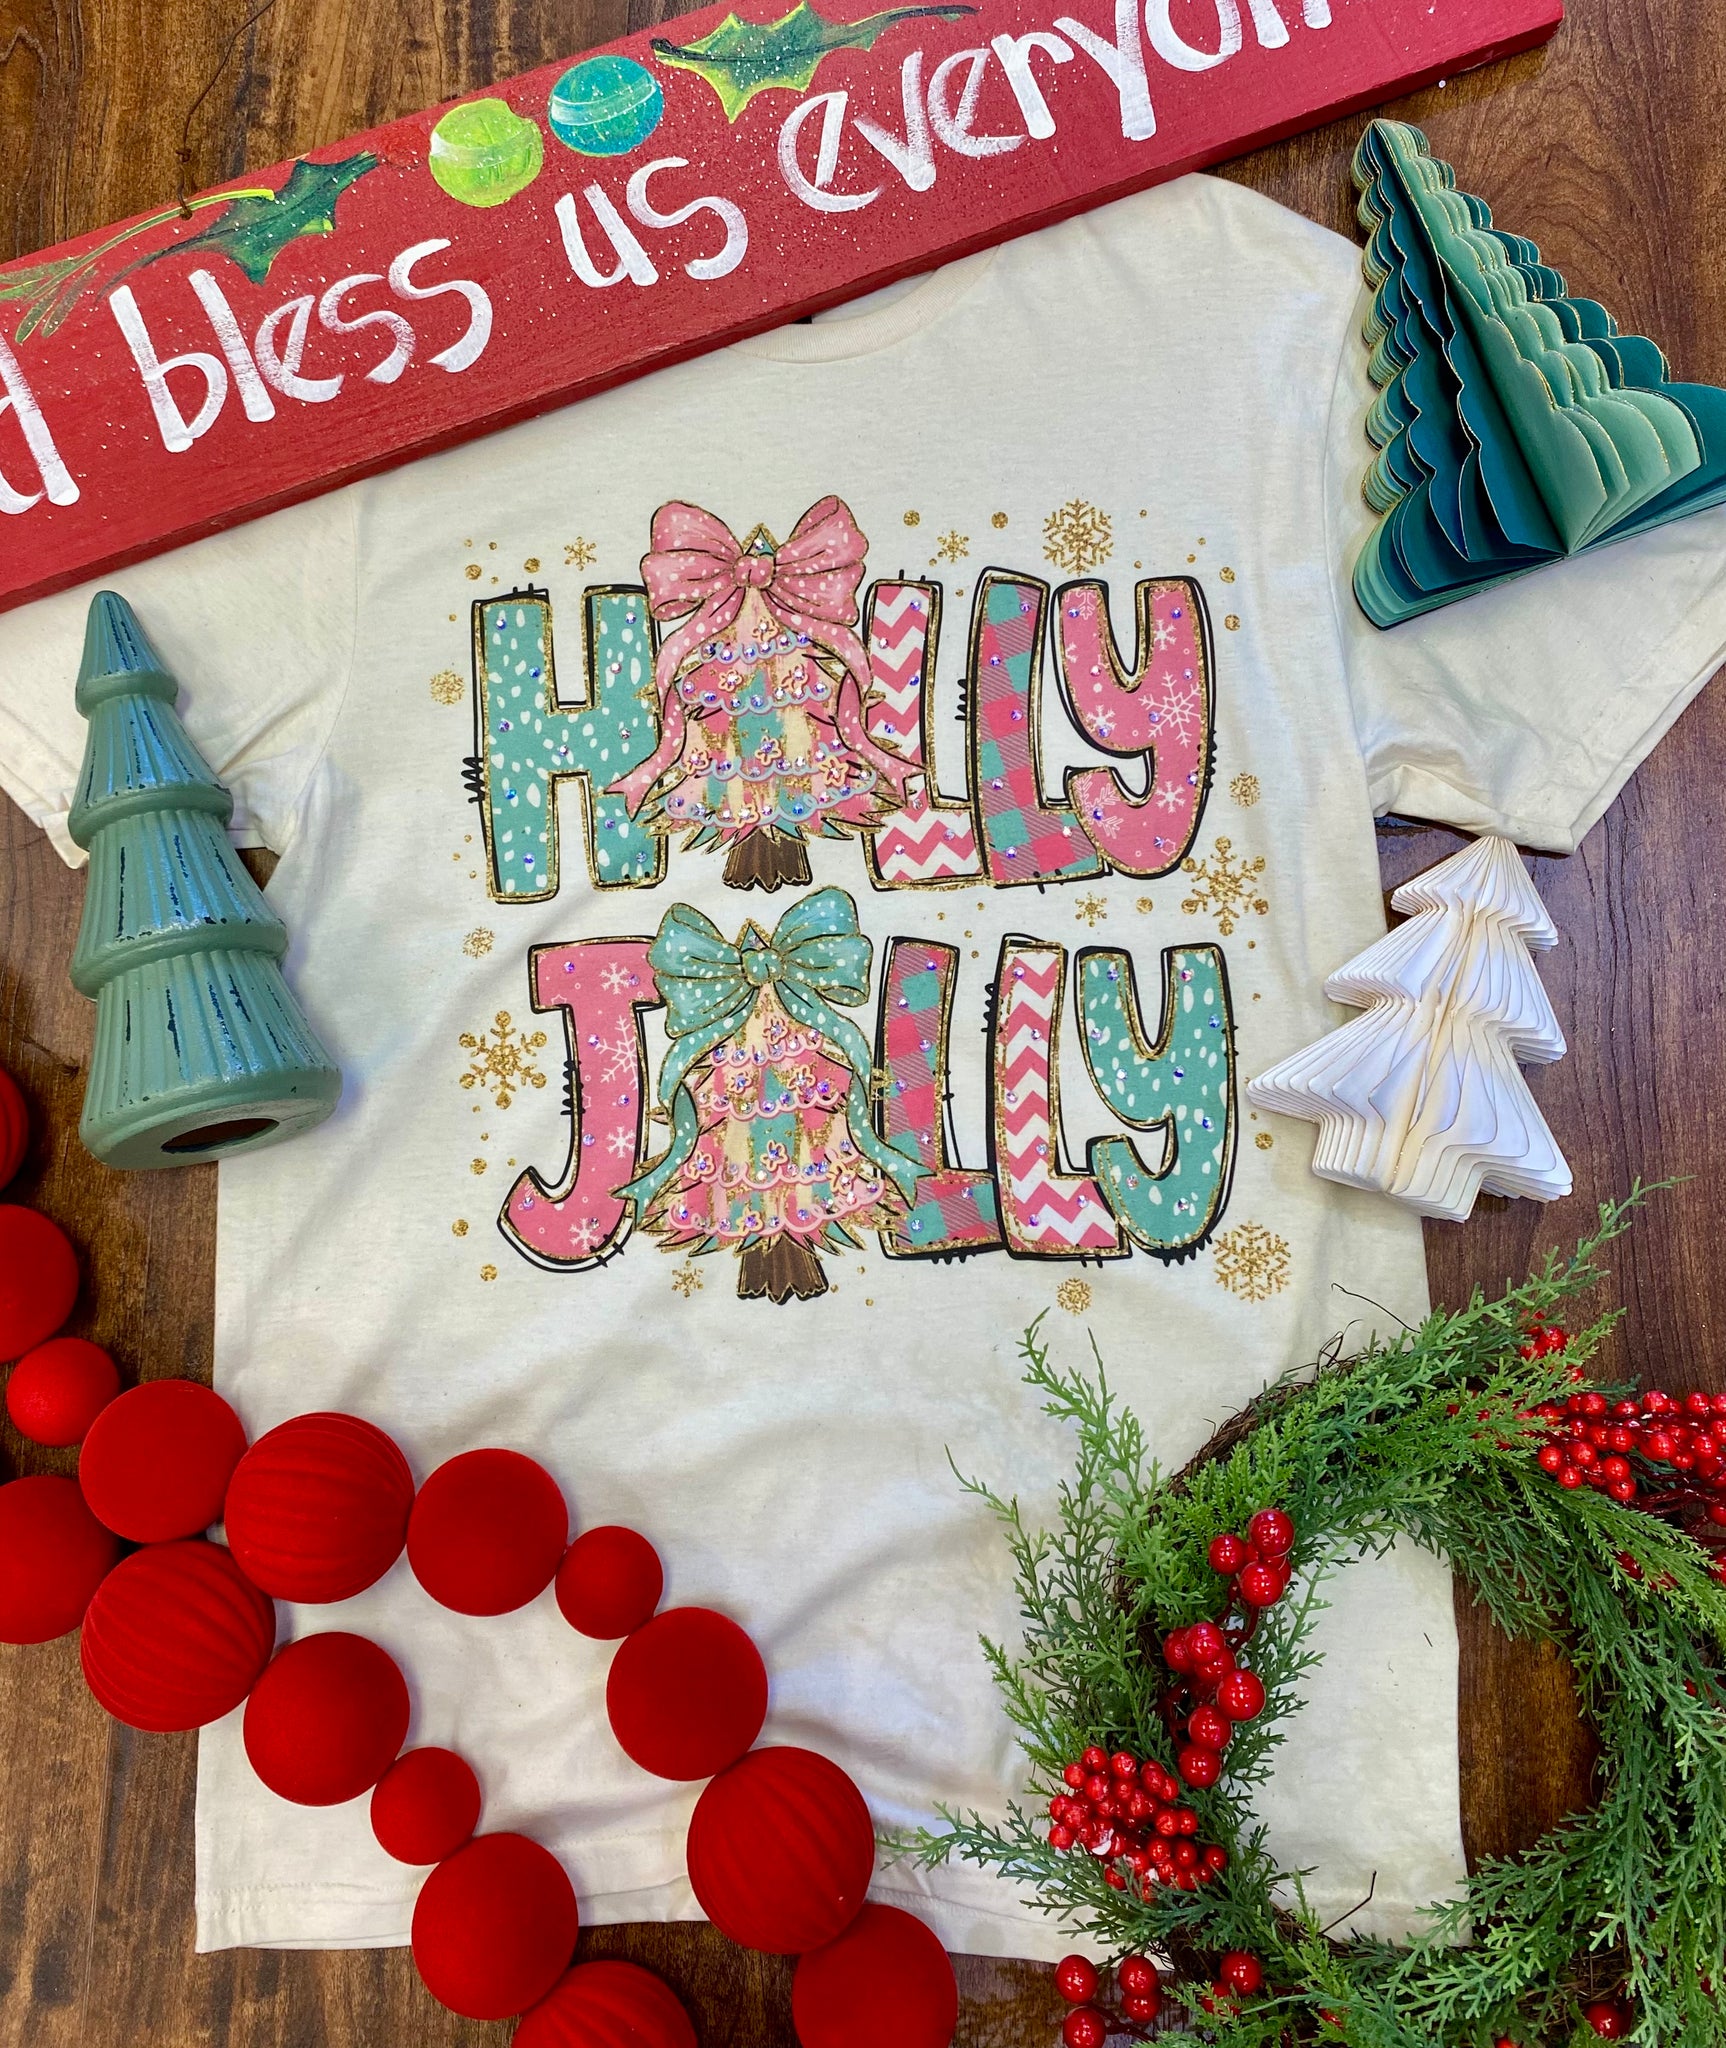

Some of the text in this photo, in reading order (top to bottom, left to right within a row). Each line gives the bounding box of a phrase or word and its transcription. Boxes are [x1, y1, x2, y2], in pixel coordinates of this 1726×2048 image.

[110, 238, 494, 453] bless
[553, 157, 749, 287] us
[468, 566, 1218, 904] HLLY
[496, 934, 1241, 1274] JLLY
